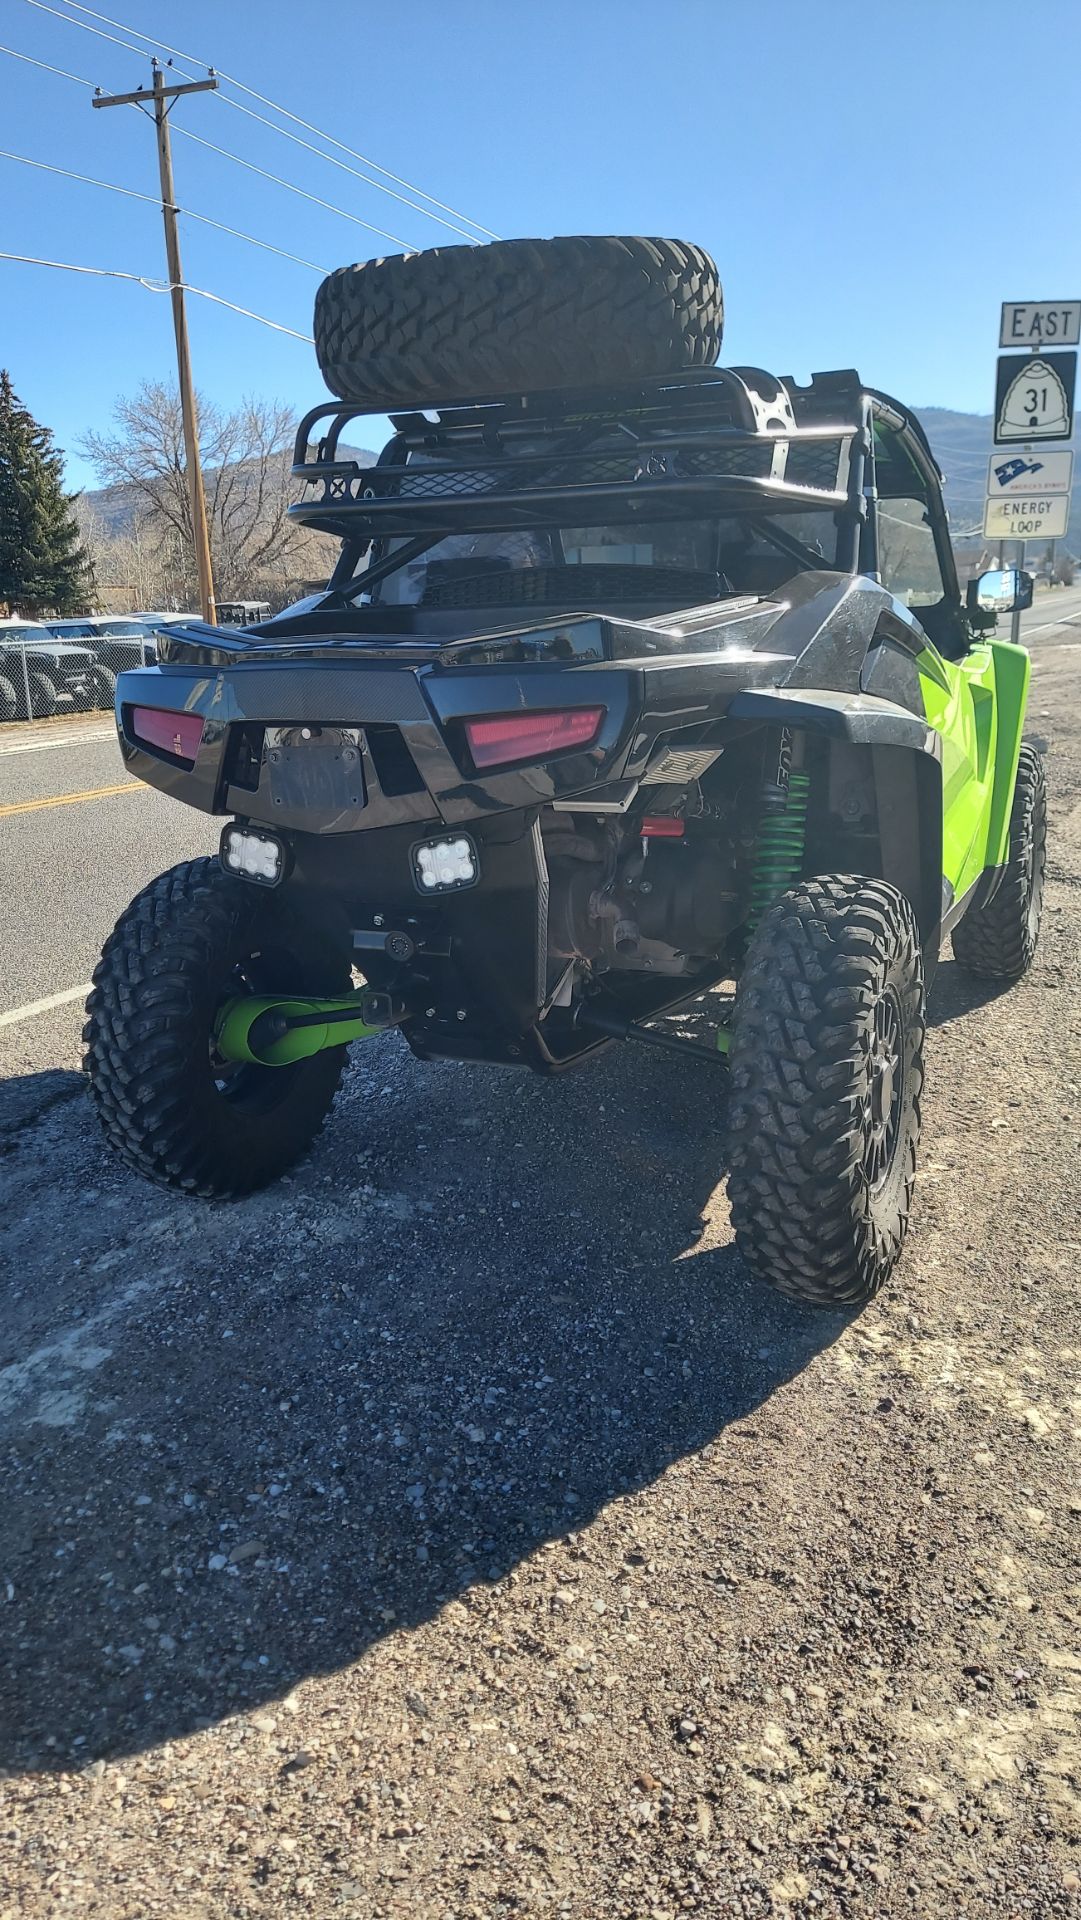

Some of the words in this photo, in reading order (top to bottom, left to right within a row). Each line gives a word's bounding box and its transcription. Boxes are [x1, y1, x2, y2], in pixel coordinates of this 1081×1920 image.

[1012, 309, 1072, 337] EAST
[1023, 388, 1047, 413] 31
[1003, 502, 1053, 516] ENERGY
[1010, 520, 1042, 534] LOOP
